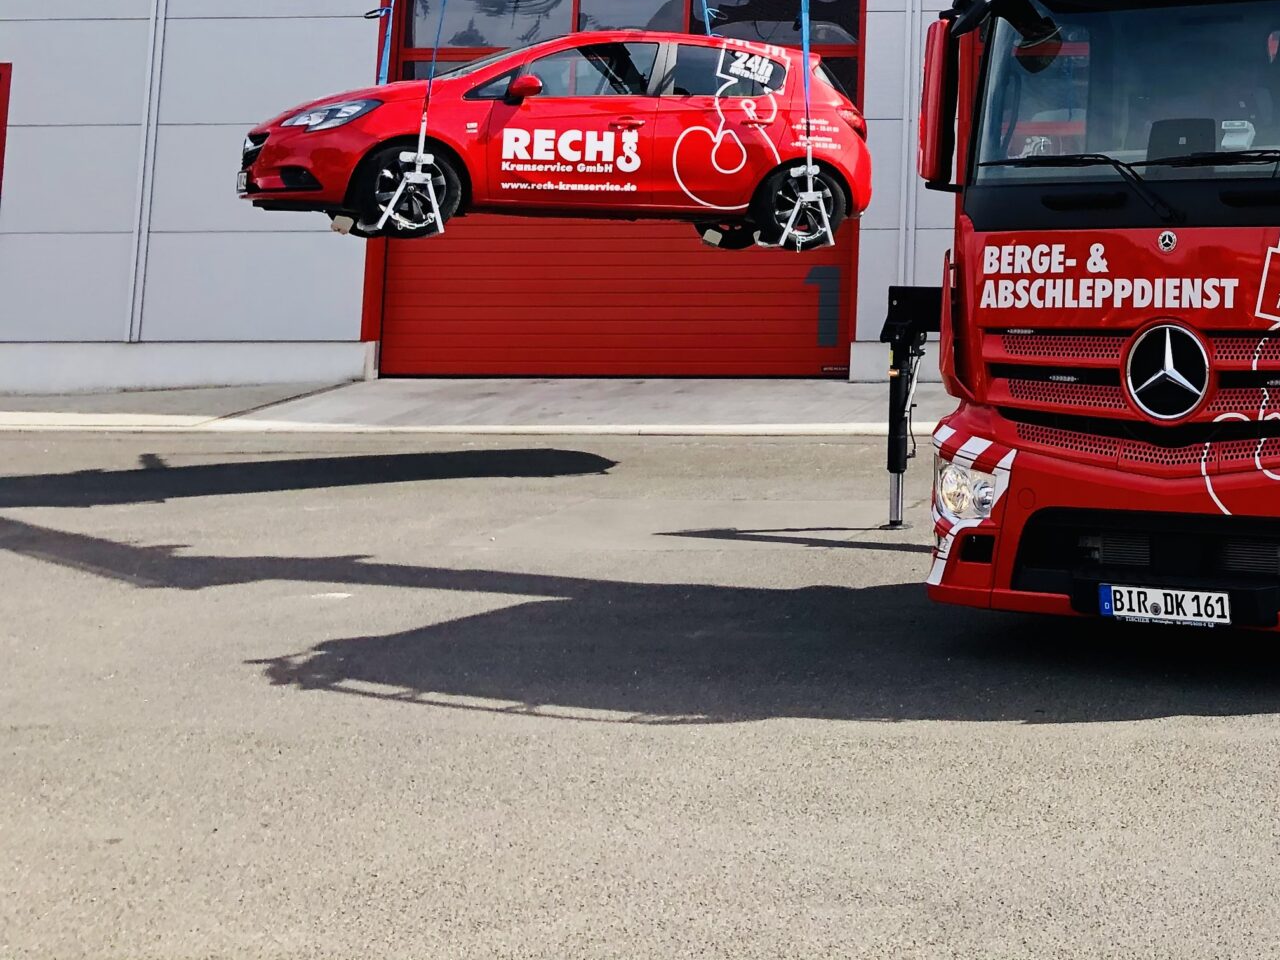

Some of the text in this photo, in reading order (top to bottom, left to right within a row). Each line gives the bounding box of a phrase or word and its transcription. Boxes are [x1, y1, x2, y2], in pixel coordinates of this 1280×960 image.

[729, 51, 774, 77] 24h
[502, 128, 615, 162] RECH
[501, 162, 613, 173] Kranservice GmbH
[501, 181, 637, 192] www.rech-kranservice.de
[983, 243, 1109, 274] BERGE- &
[804, 265, 841, 348] 1
[979, 278, 1239, 309] ABSCHLEPPDIENST
[1113, 590, 1227, 619] BIR DK 161
